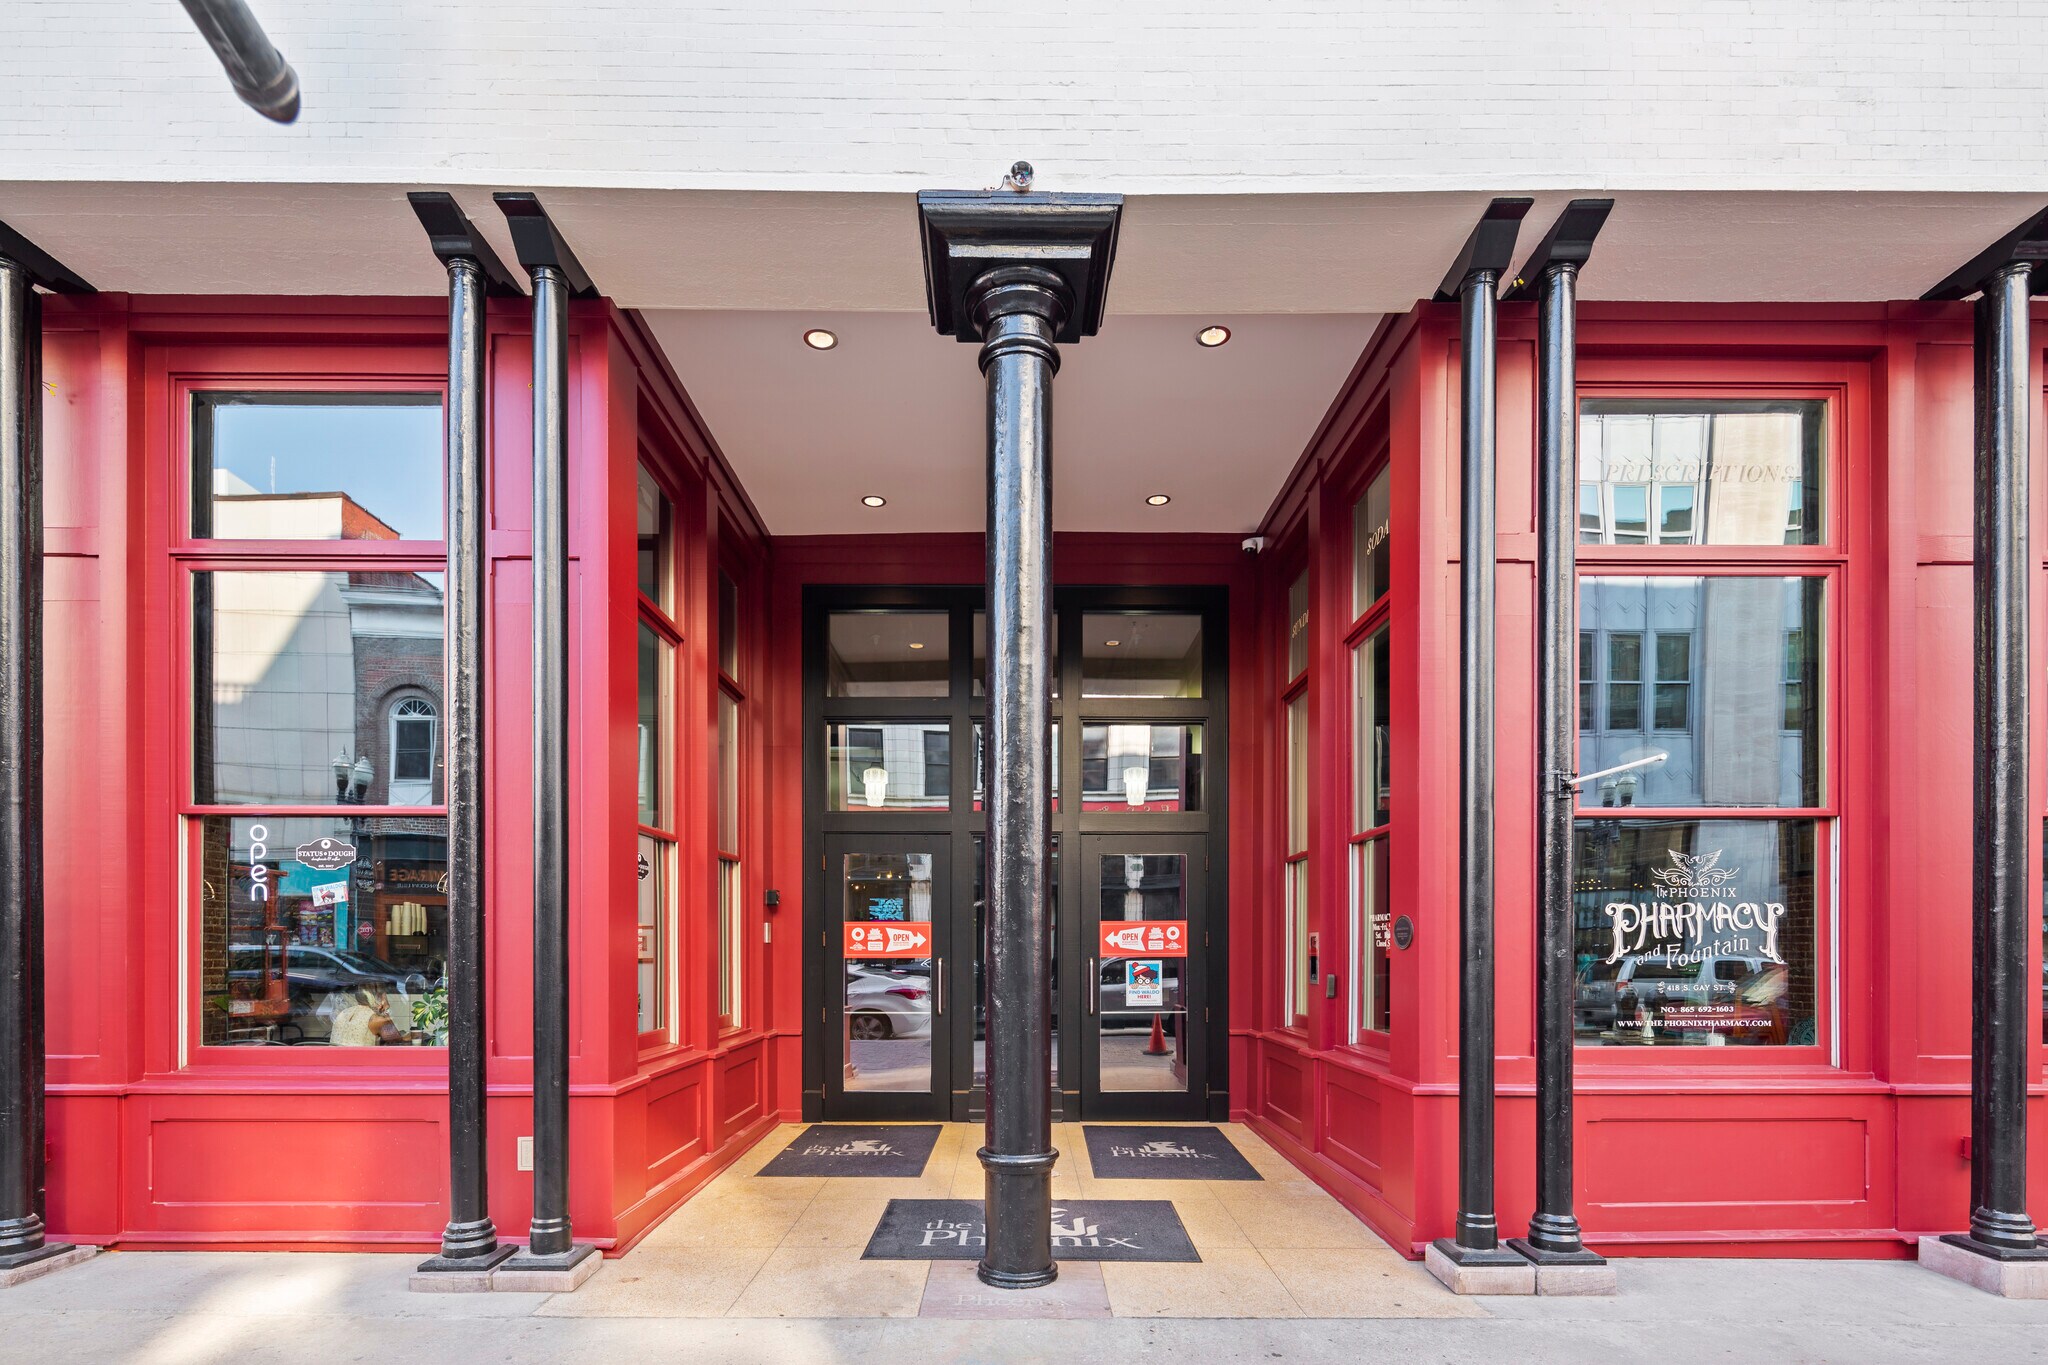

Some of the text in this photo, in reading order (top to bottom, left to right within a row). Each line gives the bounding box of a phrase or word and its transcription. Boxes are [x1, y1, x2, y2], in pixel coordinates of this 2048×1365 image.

[1366, 518, 1389, 556] SODA
[1291, 609, 1309, 639] SUND
[1654, 884, 1737, 899] The PHOENIX
[892, 933, 910, 942] OPEN
[1121, 933, 1139, 941] OPEN
[1604, 901, 1785, 966] PHARMACY
[1636, 934, 1750, 970] and Fountain
[1666, 983, 1726, 992] 418 S. GAY ST.
[1660, 1006, 1677, 1014] NO.
[1697, 1006, 1734, 1014] 692-1603
[926, 1219, 972, 1229] the
